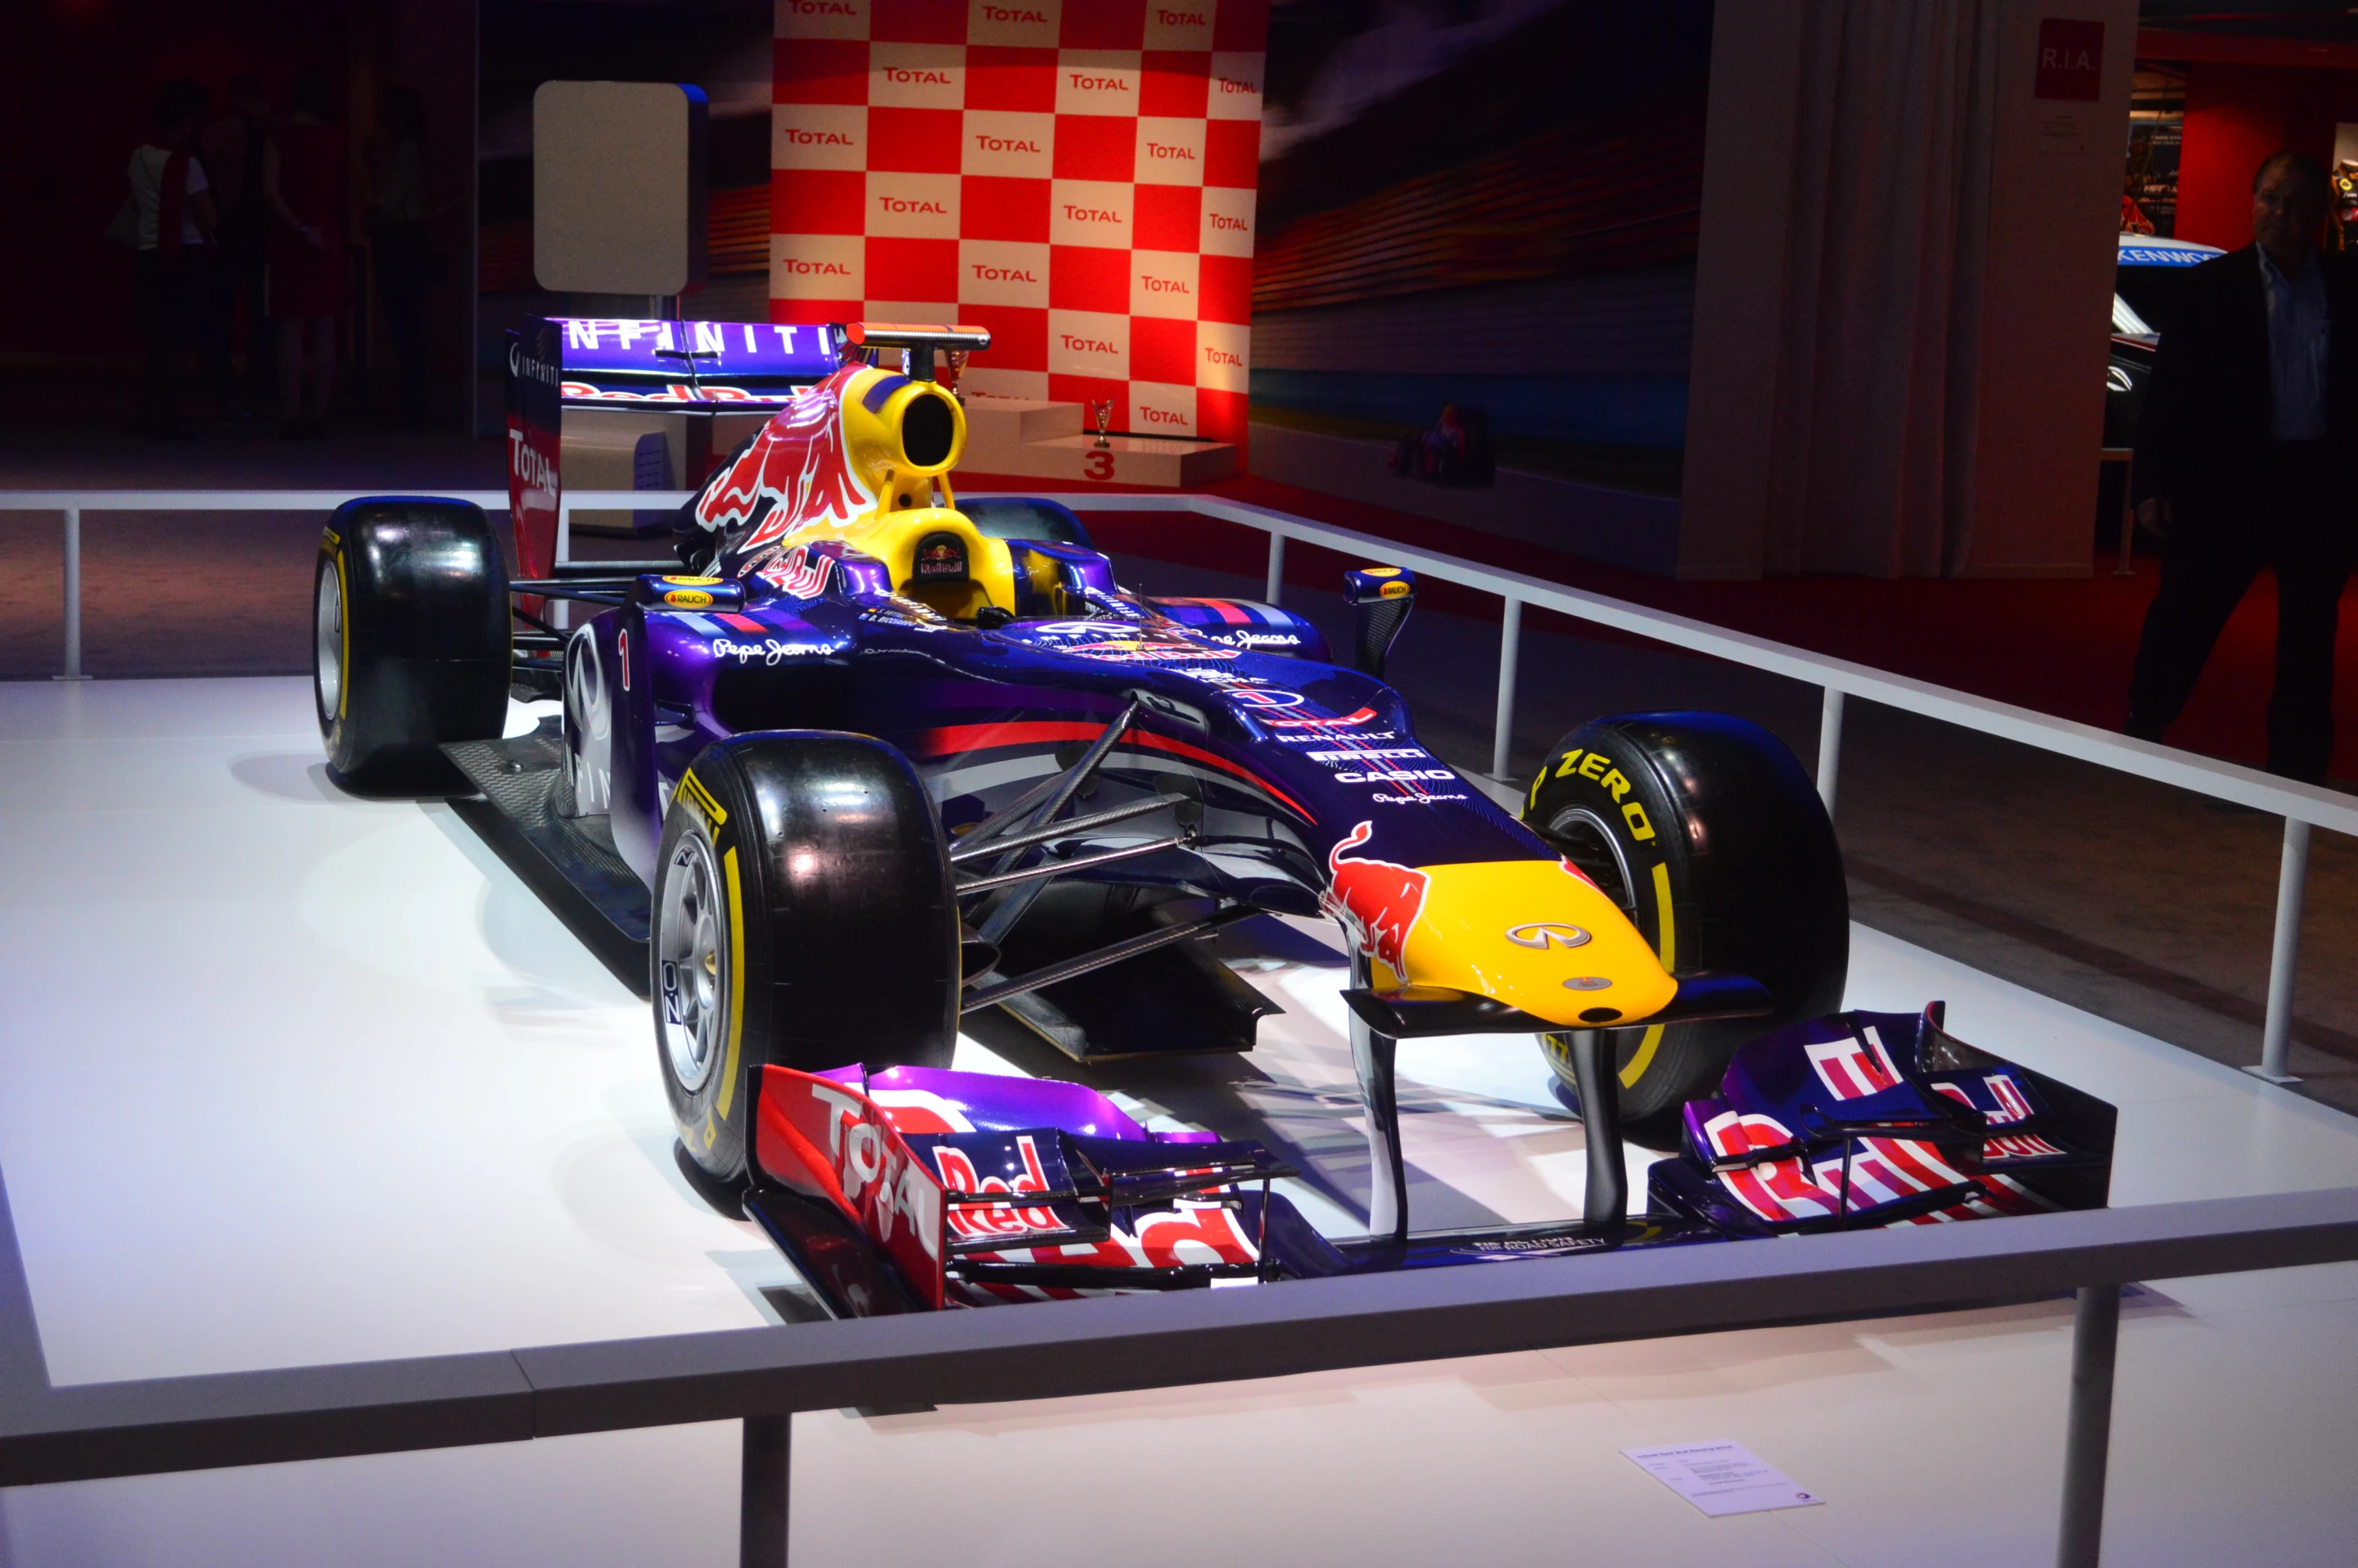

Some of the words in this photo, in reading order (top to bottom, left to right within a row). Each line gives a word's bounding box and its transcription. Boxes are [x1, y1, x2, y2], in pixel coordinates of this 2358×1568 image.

[982, 5, 1048, 23] TOTAL
[1156, 10, 1206, 26] TOTAL
[2043, 47, 2096, 71] R.I.A.
[883, 66, 951, 84] TOTAL
[1069, 75, 1129, 91] TOTAL
[1217, 77, 1257, 94] TOTAL
[785, 129, 853, 146] TOTAL
[976, 135, 1041, 153] TOTAL
[1147, 142, 1195, 160] TOTAL
[879, 197, 947, 214] TOTAL
[1064, 206, 1122, 223] TOTAL
[1209, 214, 1248, 231] TOTAL
[2118, 250, 2217, 264] KENWO
[783, 259, 851, 275] TOTAL
[972, 264, 1037, 282] TOTAL
[1141, 276, 1190, 293] TOTAL
[569, 320, 830, 355] NFINITI
[1061, 335, 1118, 354] TOTAL
[1205, 348, 1243, 367] TOTAL
[522, 355, 558, 387] INFINITI
[1139, 406, 1188, 426] TOTAL
[509, 428, 557, 498] TOTAL
[1084, 451, 1114, 481] 3
[921, 563, 942, 573] Red
[942, 561, 962, 572] Bull
[1388, 585, 1406, 594] RAUCH
[678, 594, 707, 603] RAUCH
[1236, 630, 1301, 649] Jeans
[618, 629, 630, 691] 1
[713, 639, 766, 664] Pepe
[766, 639, 835, 666] Jeans
[1154, 649, 1242, 660] Bull
[1231, 691, 1277, 703] 1
[1276, 731, 1395, 743] RENAULT
[1306, 749, 1426, 761] PIRELLI
[1335, 770, 1455, 783] CASIO
[1372, 793, 1416, 805] Pepe
[1415, 793, 1468, 803] Jeans
[1530, 766, 1547, 811] P
[1556, 748, 1656, 842] ZERO
[812, 1084, 940, 1262] TOTAL
[1504, 1241, 1547, 1251] ROAD
[1549, 1237, 1606, 1248] SAFETY
